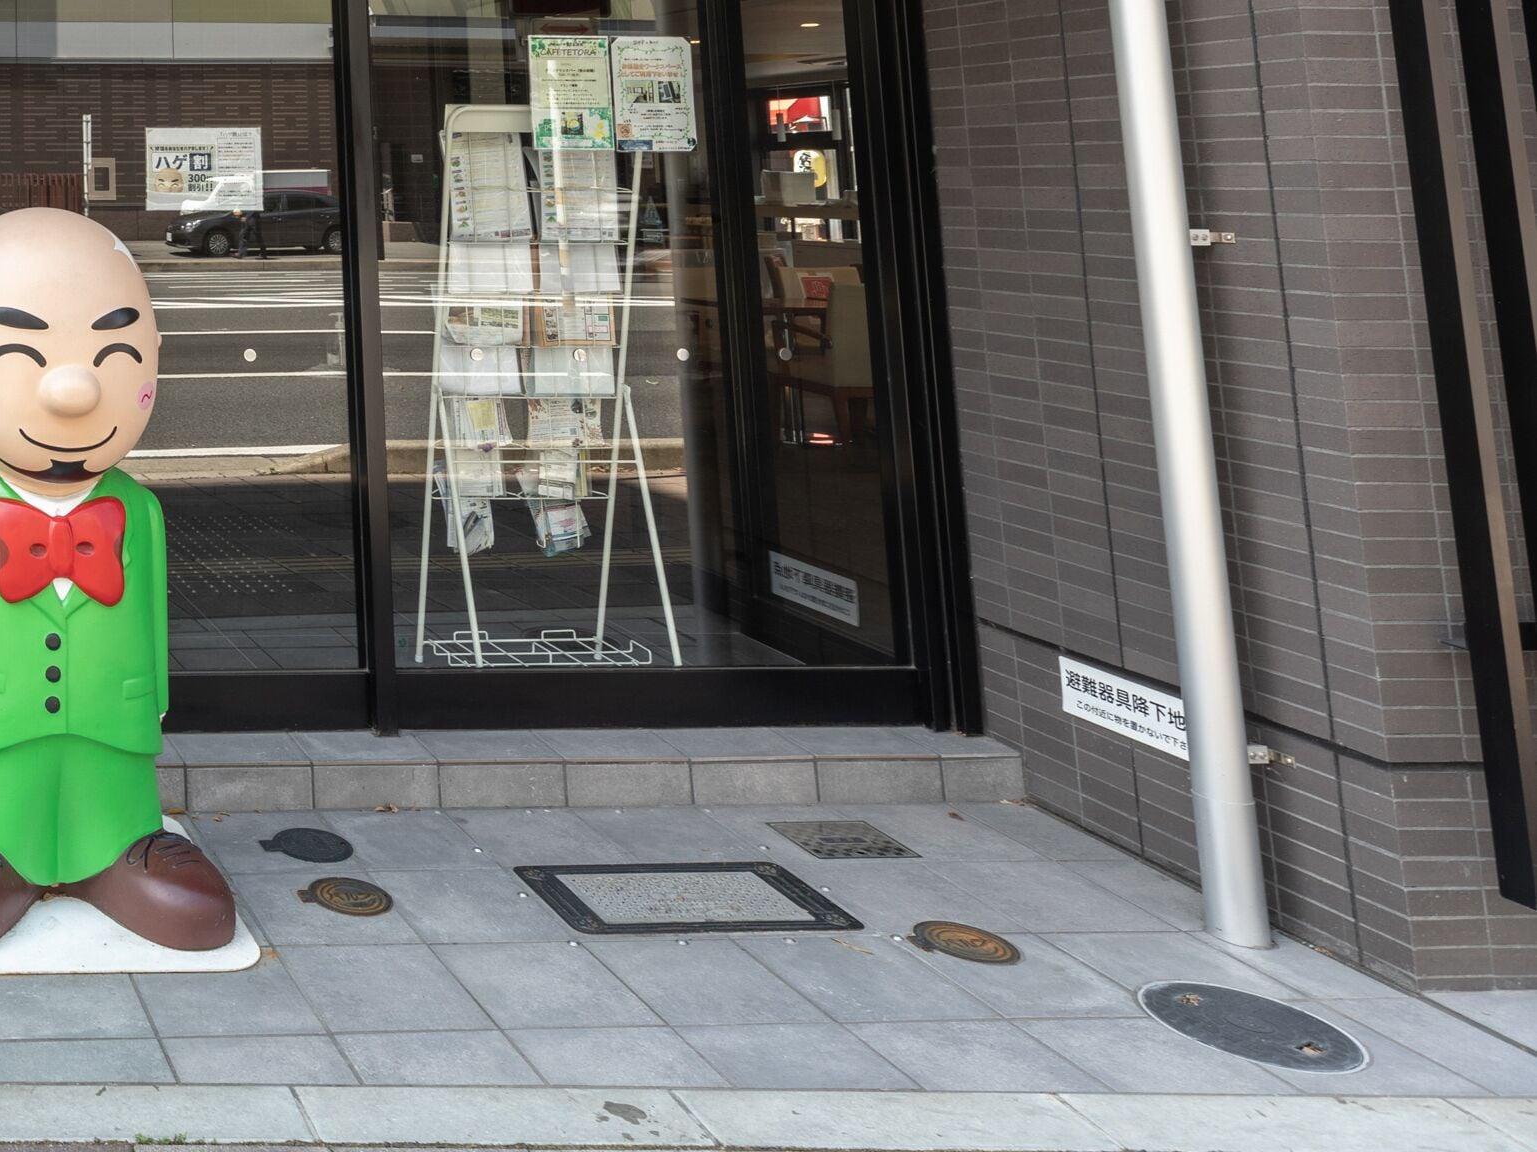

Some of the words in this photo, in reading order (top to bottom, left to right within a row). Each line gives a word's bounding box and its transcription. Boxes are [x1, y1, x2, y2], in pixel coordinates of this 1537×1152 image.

[1065, 668, 1186, 732] 避難器具降下地
[1075, 699, 1188, 751] この付近に物を置かないで下さ
